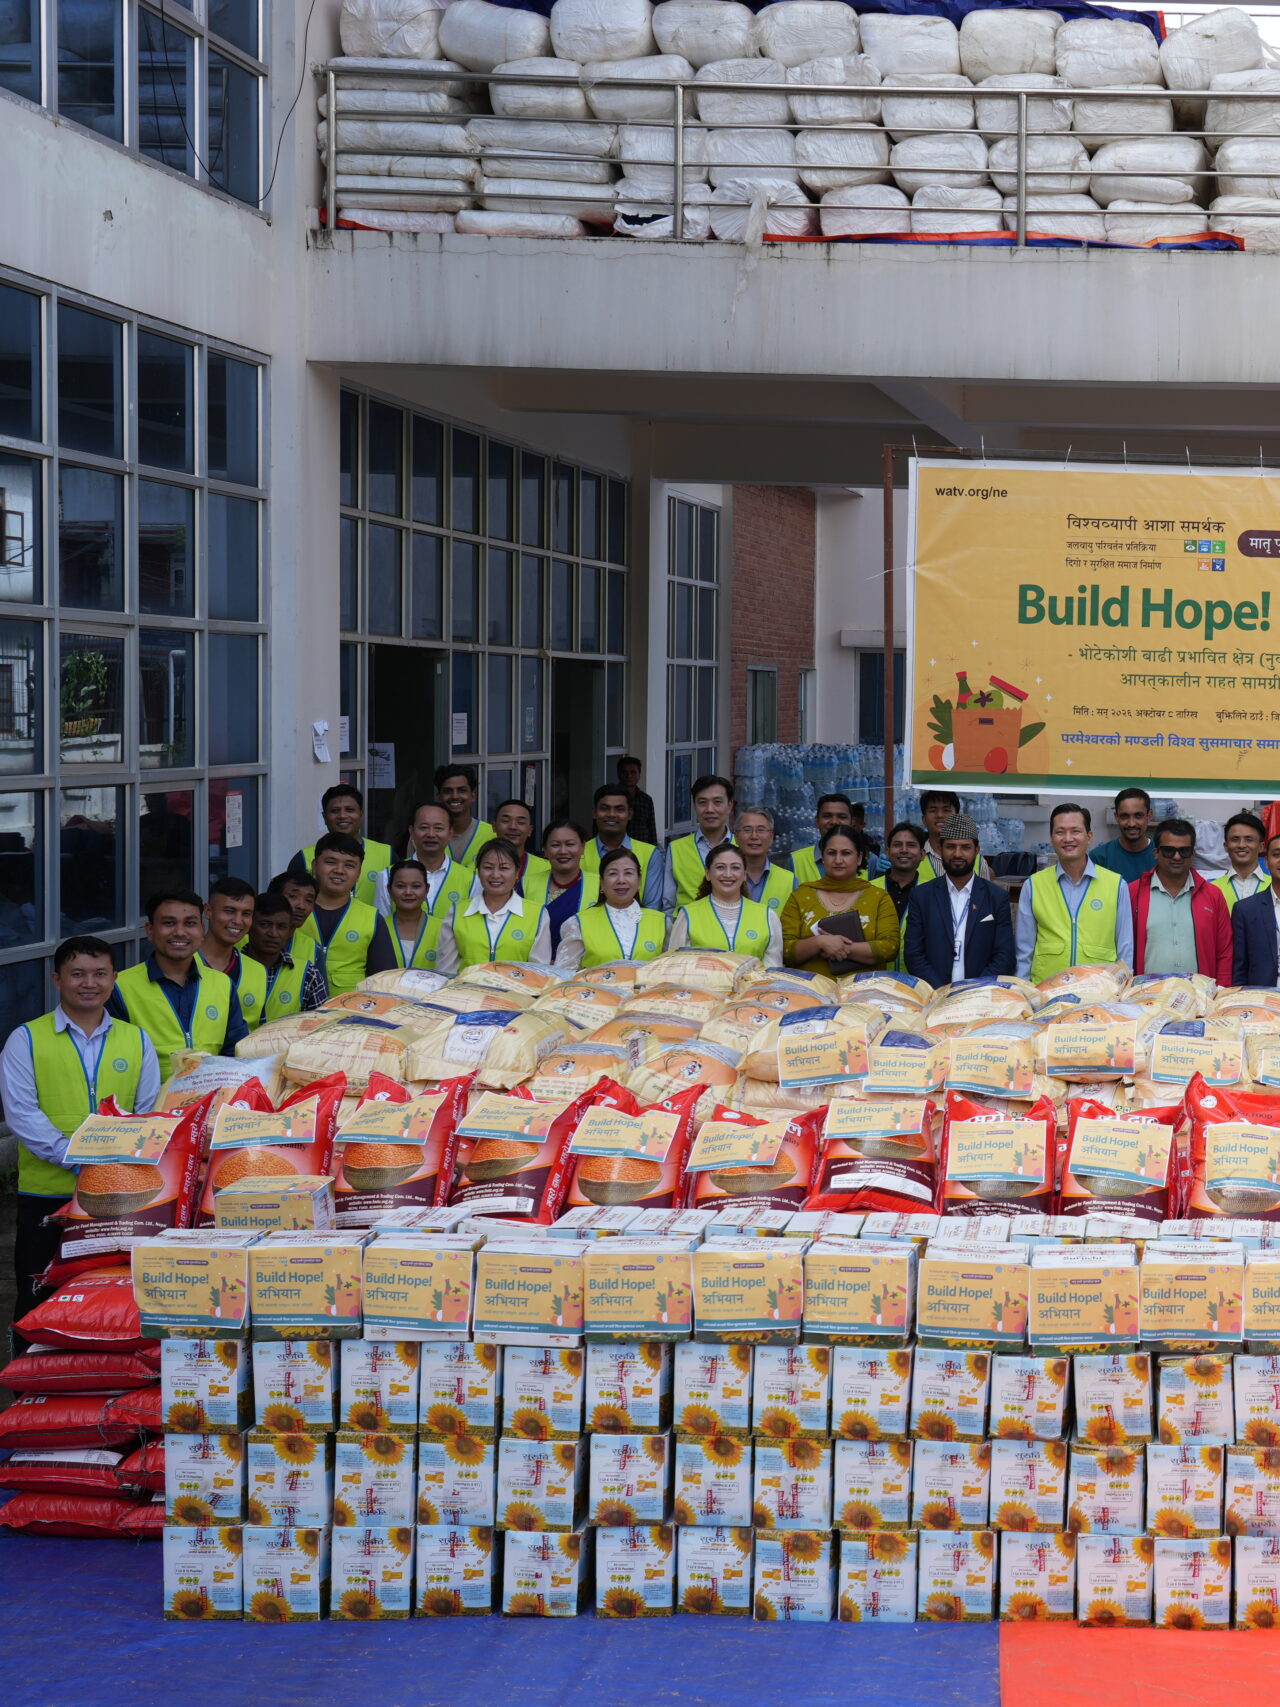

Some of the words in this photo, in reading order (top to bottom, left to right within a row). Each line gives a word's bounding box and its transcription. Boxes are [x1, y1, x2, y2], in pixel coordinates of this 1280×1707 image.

[936, 486, 1007, 499] watv.org/ne
[1066, 514, 1138, 530] विश्वव्यापी
[1143, 520, 1175, 532] आशा
[1180, 517, 1226, 533] समर्थक
[1066, 541, 1093, 552] जलवायु
[1096, 540, 1123, 551] परिवर्तन
[1249, 537, 1271, 554] मातृ
[1084, 560, 1087, 568] र
[1090, 558, 1114, 571] सुरक्षित
[1117, 560, 1138, 569] समाज
[1140, 559, 1161, 570] निर्माण
[1018, 584, 1129, 629] Build
[1141, 588, 1271, 641] Hope!
[1079, 644, 1137, 662] भोटेकोशी
[1142, 646, 1171, 663] बाढी
[1177, 647, 1227, 664] प्रभावित
[1233, 648, 1255, 666] क्षेत्र
[1121, 672, 1201, 693] आपत्कालीन
[1206, 674, 1236, 689] राहत
[1073, 705, 1089, 716] मिति
[1096, 708, 1108, 719] सन्
[1136, 707, 1165, 718] अक्टोबर
[1176, 709, 1198, 719] तारिख
[1061, 730, 1120, 745] परमेश्वरको
[1125, 732, 1164, 747] मण्डली
[1168, 733, 1195, 747] विश्व
[1199, 736, 1252, 751] सुसमाचार
[785, 1044, 809, 1056] Build
[811, 1042, 837, 1054] Hope!
[1161, 1044, 1184, 1053] Build
[1186, 1046, 1213, 1056] Hope!
[956, 1053, 978, 1063] Build
[981, 1053, 1007, 1064] Hope!
[957, 1141, 982, 1152] Build
[984, 1140, 1013, 1152] Hope!
[1082, 1134, 1106, 1146] Build
[1108, 1136, 1139, 1150] Hope!
[1213, 1143, 1237, 1155] Build
[1239, 1144, 1269, 1156] Hope!
[221, 1216, 246, 1228] Build
[249, 1216, 281, 1229] Hope!
[142, 1272, 172, 1283] Build
[176, 1273, 209, 1286] Hope!
[256, 1271, 285, 1283] Build
[288, 1271, 324, 1287] Hope!
[366, 1272, 395, 1284] Build
[399, 1274, 432, 1289] Hope!
[589, 1278, 618, 1290] Build
[622, 1278, 655, 1293] Hope!
[144, 1287, 187, 1300] अभियान
[257, 1288, 301, 1300] अभियान
[366, 1288, 409, 1302] अभियान
[589, 1294, 633, 1306] अभियान
[927, 1285, 956, 1297] Build
[959, 1287, 993, 1303] Hope!
[1142, 1287, 1171, 1299] Build
[1174, 1288, 1207, 1302] Hope!
